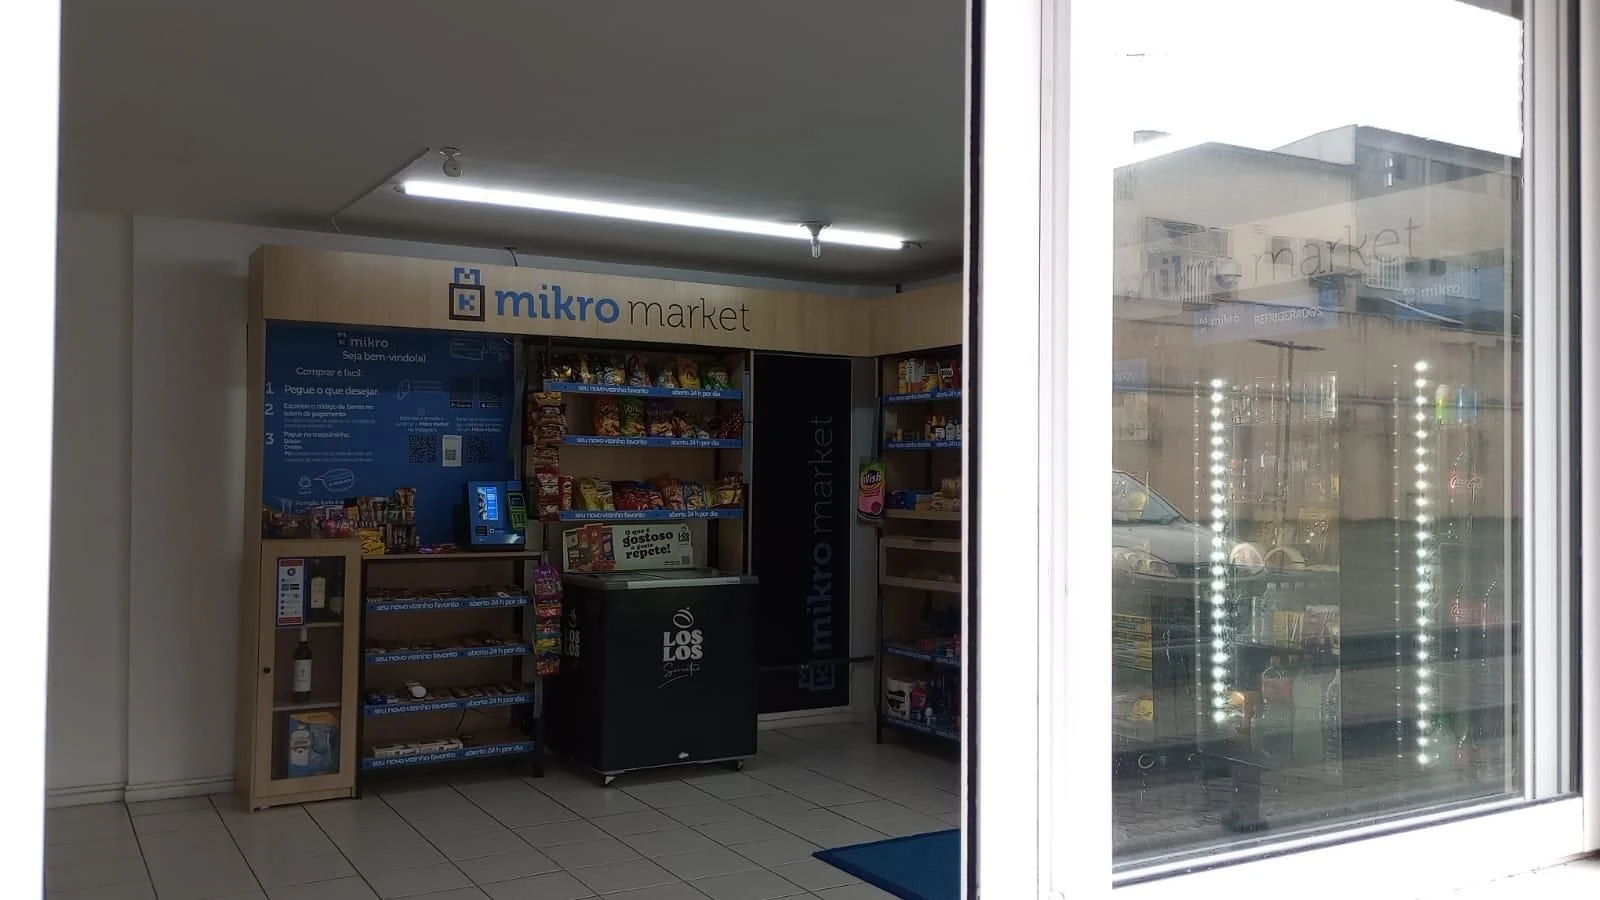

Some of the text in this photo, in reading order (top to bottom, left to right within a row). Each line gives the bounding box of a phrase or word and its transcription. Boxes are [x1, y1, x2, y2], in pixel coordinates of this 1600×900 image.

[1251, 217, 1421, 285] market
[495, 284, 750, 332] mikro market
[1211, 313, 1240, 326] mikro
[350, 336, 389, 348] mikro
[342, 350, 427, 364] Seja bem-vindo(a)
[296, 367, 336, 377] Comprar
[265, 382, 275, 395] 1
[285, 384, 315, 396] Pegue
[324, 388, 344, 397] que
[345, 386, 381, 398] desejar.
[264, 403, 275, 416] 2
[265, 431, 275, 446] 3
[622, 531, 674, 547] gostoso
[806, 415, 833, 653] mikro market
[625, 543, 671, 560] repete!
[663, 629, 703, 647] LOS
[663, 644, 703, 662] LOS
